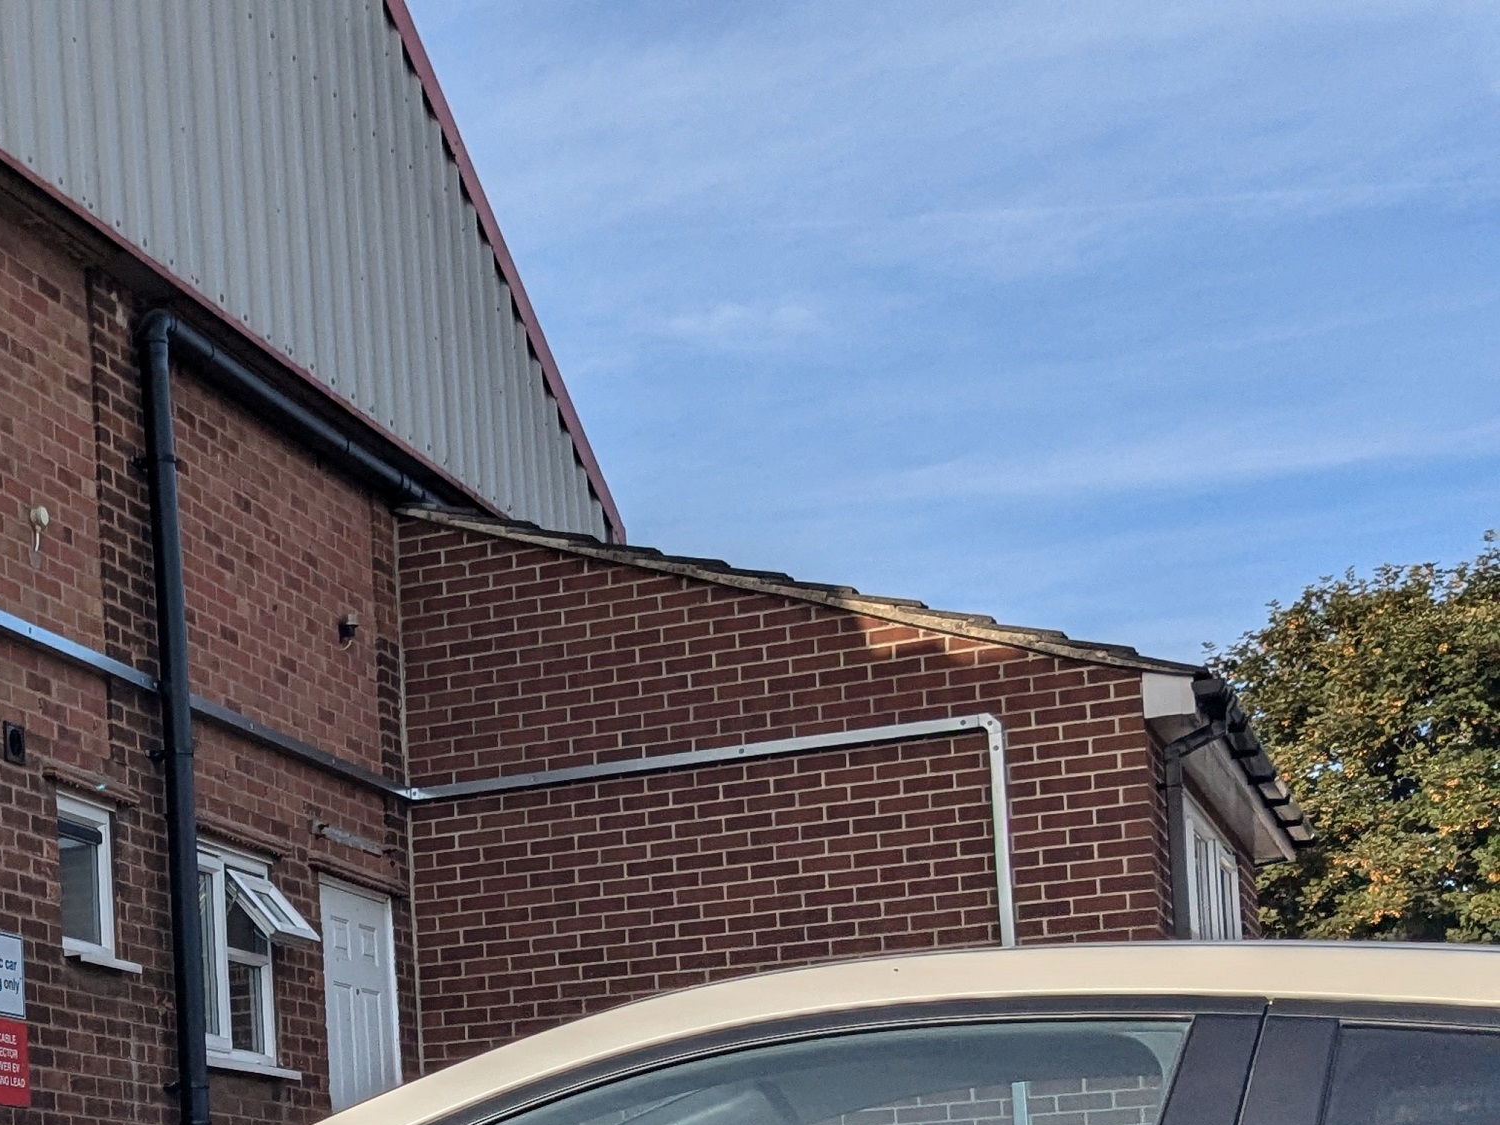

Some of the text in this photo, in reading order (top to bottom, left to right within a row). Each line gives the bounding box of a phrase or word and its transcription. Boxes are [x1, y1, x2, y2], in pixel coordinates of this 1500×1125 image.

[5, 959, 17, 971] car
[4, 978, 19, 994] only
[12, 1063, 20, 1073] EV
[10, 1076, 26, 1088] LEAD
